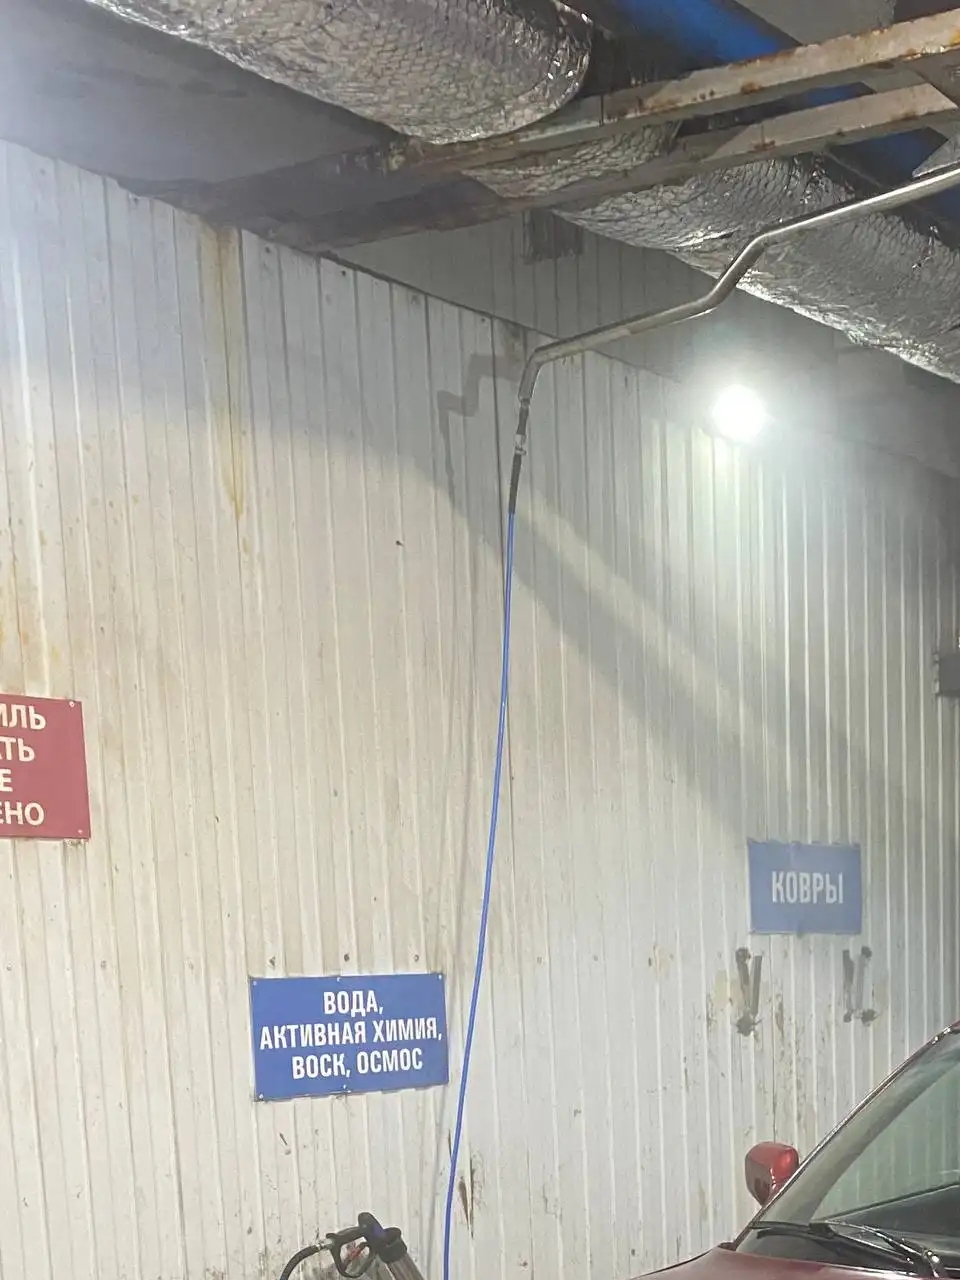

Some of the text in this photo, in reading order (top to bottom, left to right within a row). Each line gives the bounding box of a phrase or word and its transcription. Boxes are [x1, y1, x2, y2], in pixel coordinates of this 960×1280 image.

[0, 736, 36, 762] ТЬ
[0, 800, 45, 826] НО
[772, 871, 843, 904] КОВРЫ
[323, 990, 384, 1018] ВОДА,
[260, 1017, 443, 1050] АКТИВНАЯ ХИМИЯ,
[292, 1048, 424, 1080] ВОСК, ОСМОС
